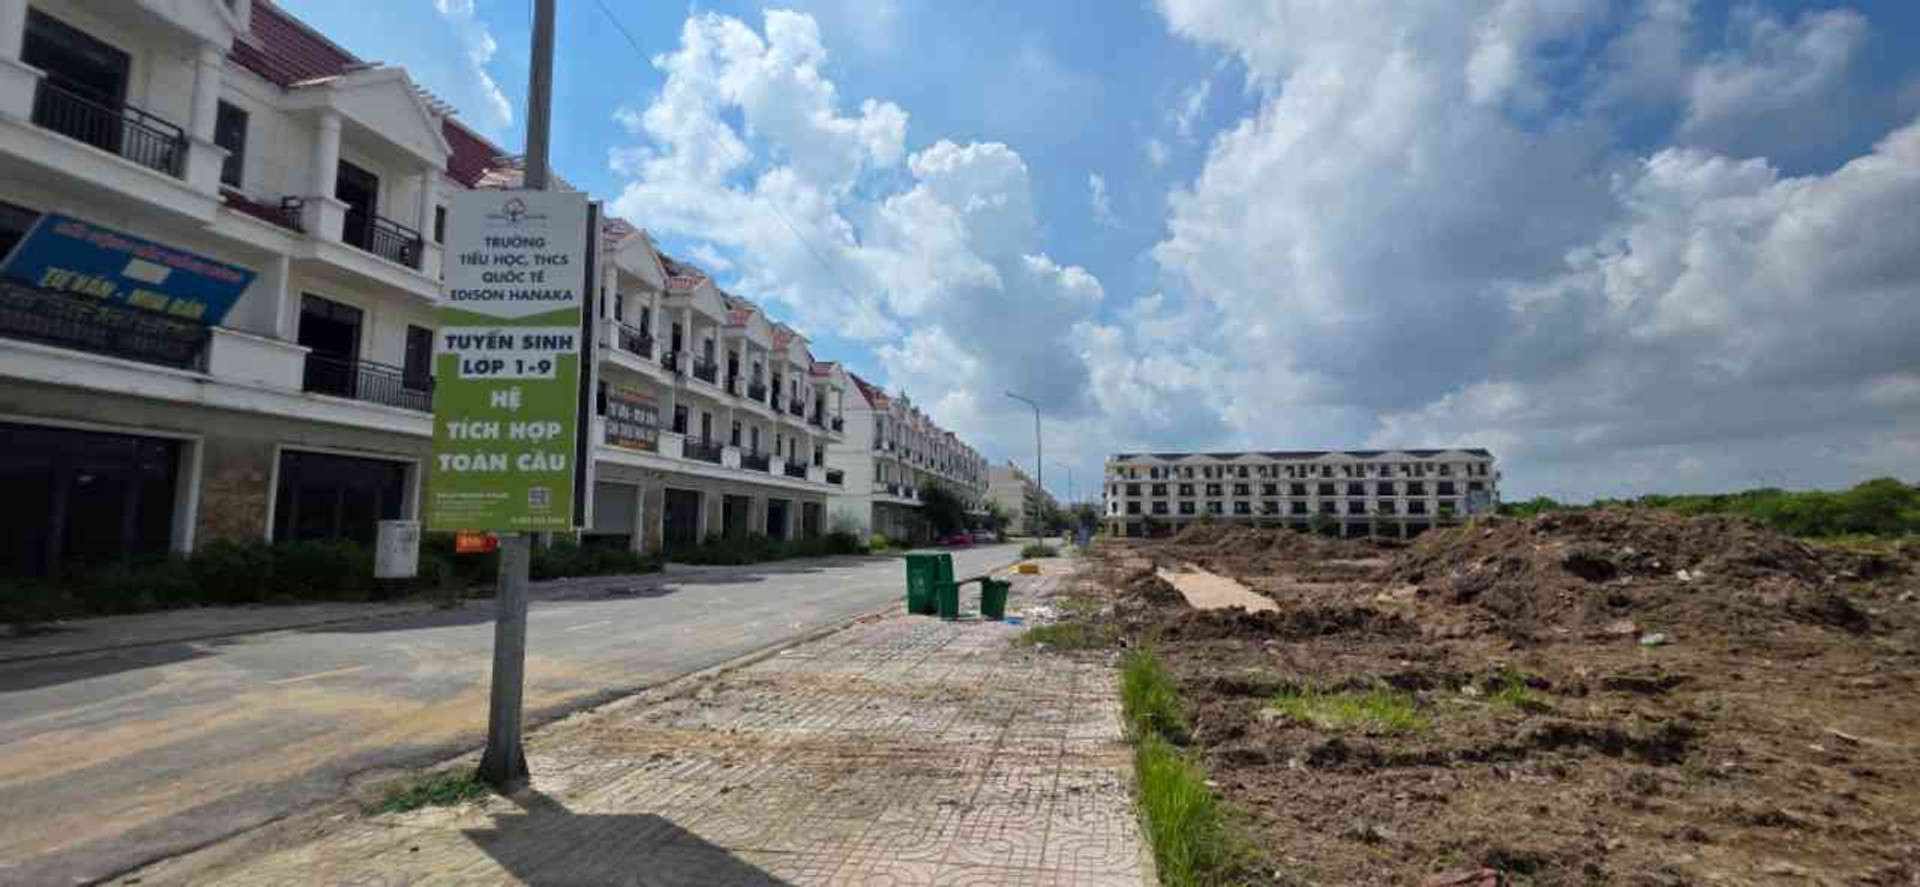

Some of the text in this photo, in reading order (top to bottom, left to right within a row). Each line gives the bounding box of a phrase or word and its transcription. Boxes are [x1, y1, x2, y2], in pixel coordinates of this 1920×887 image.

[493, 254, 530, 267] HỌC,
[534, 254, 569, 266] THCS
[451, 289, 572, 301] EDISON HANAKA
[444, 330, 574, 350] TUYỂN SINH
[516, 359, 551, 375] 1-9
[490, 386, 522, 411] HỆ
[446, 417, 562, 443] TÍCH HỢP
[516, 448, 566, 472] CẦU
